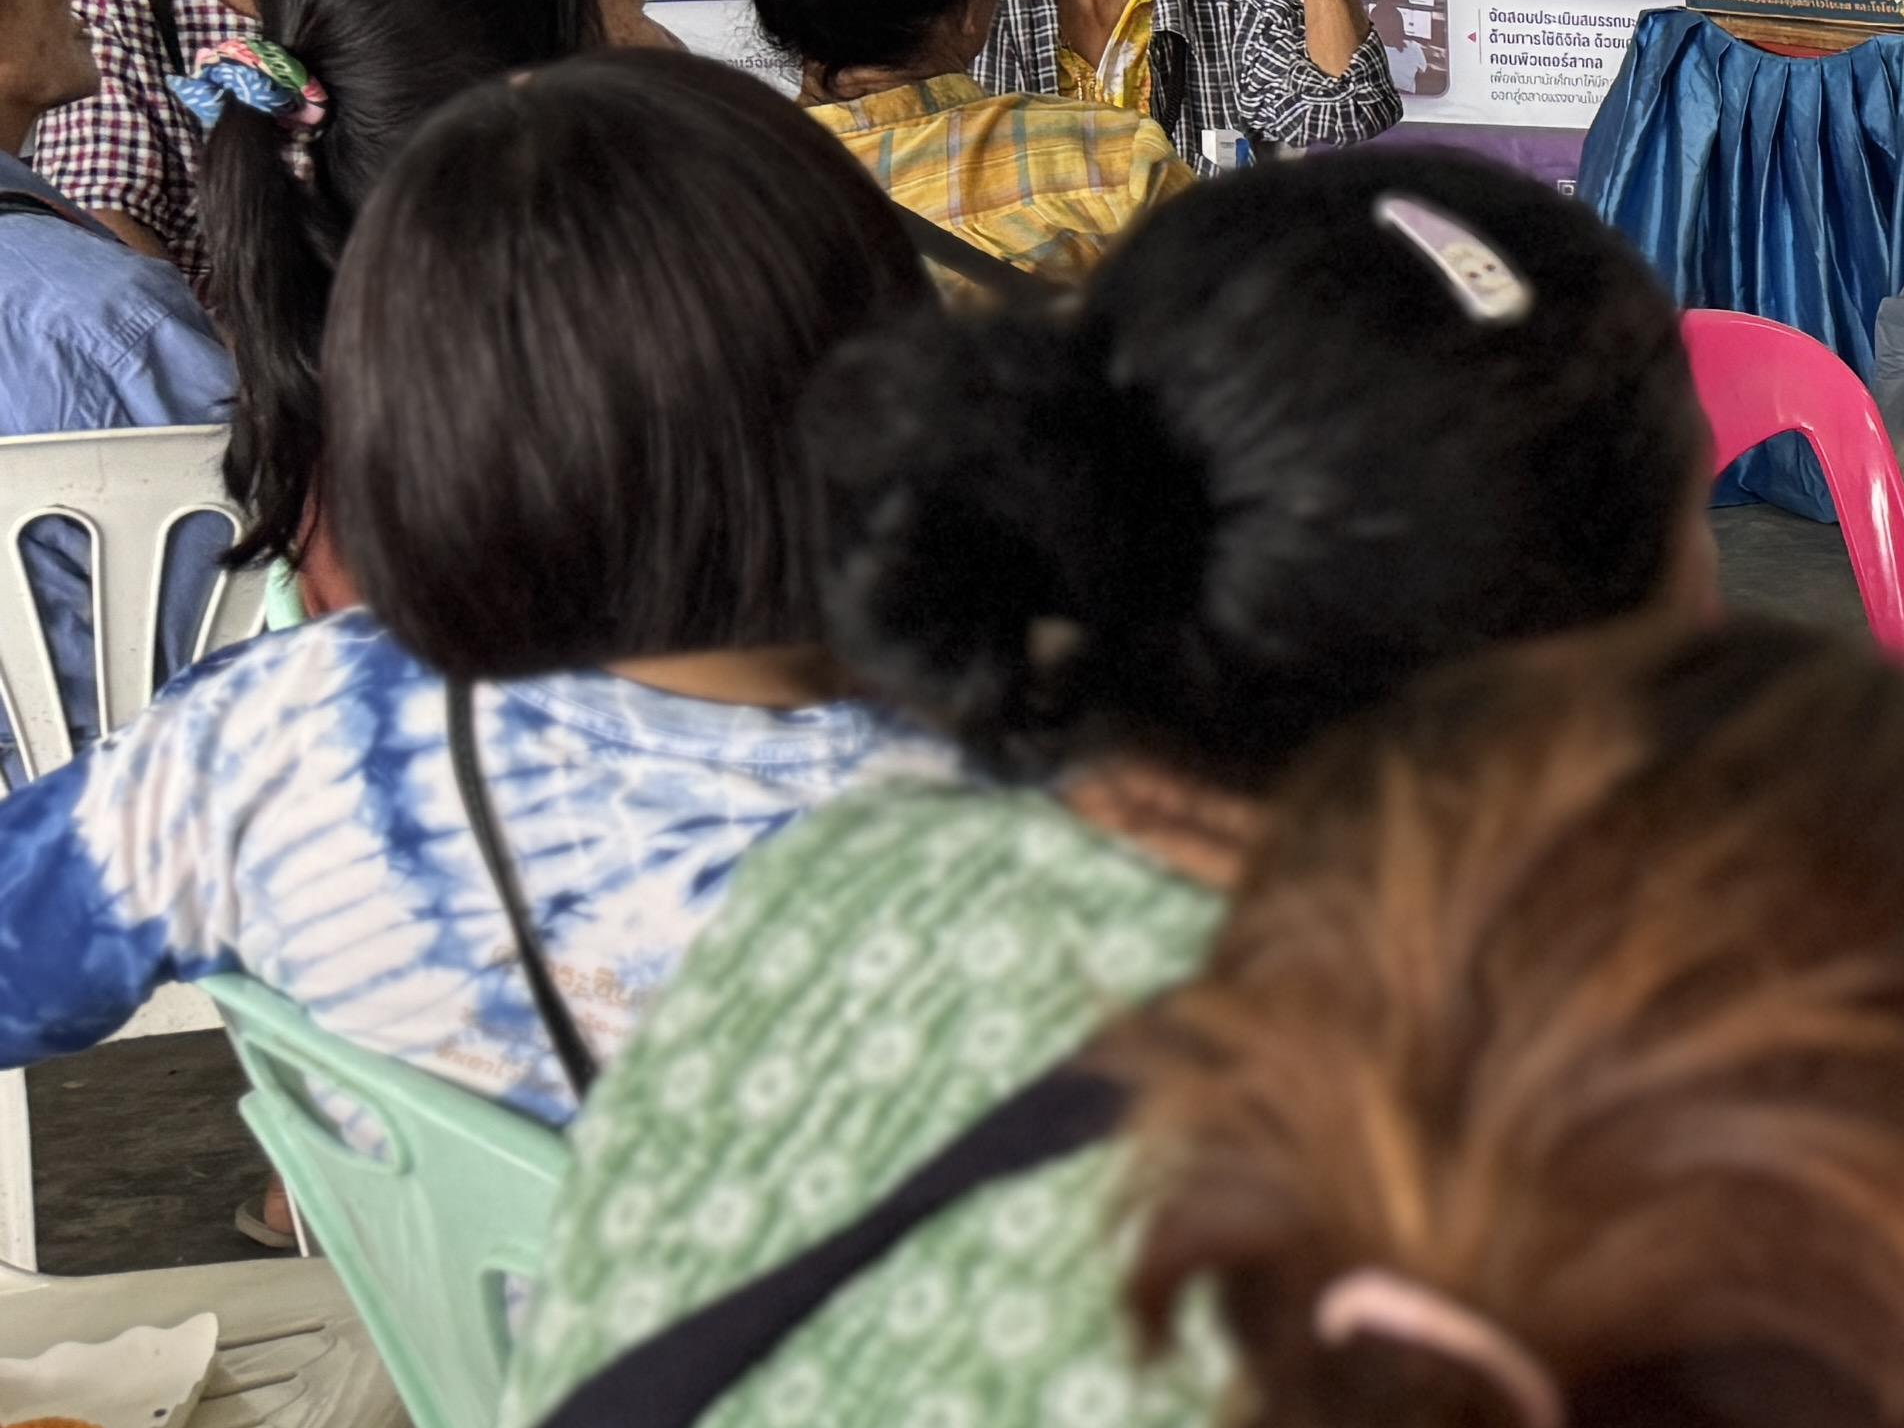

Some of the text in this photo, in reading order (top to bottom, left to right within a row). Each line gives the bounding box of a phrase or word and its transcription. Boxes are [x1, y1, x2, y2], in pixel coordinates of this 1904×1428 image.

[1489, 29, 1590, 47] ด้านการใช้ดิจิทัล
[1490, 52, 1603, 69] คอมพิวเตอร์สากล
